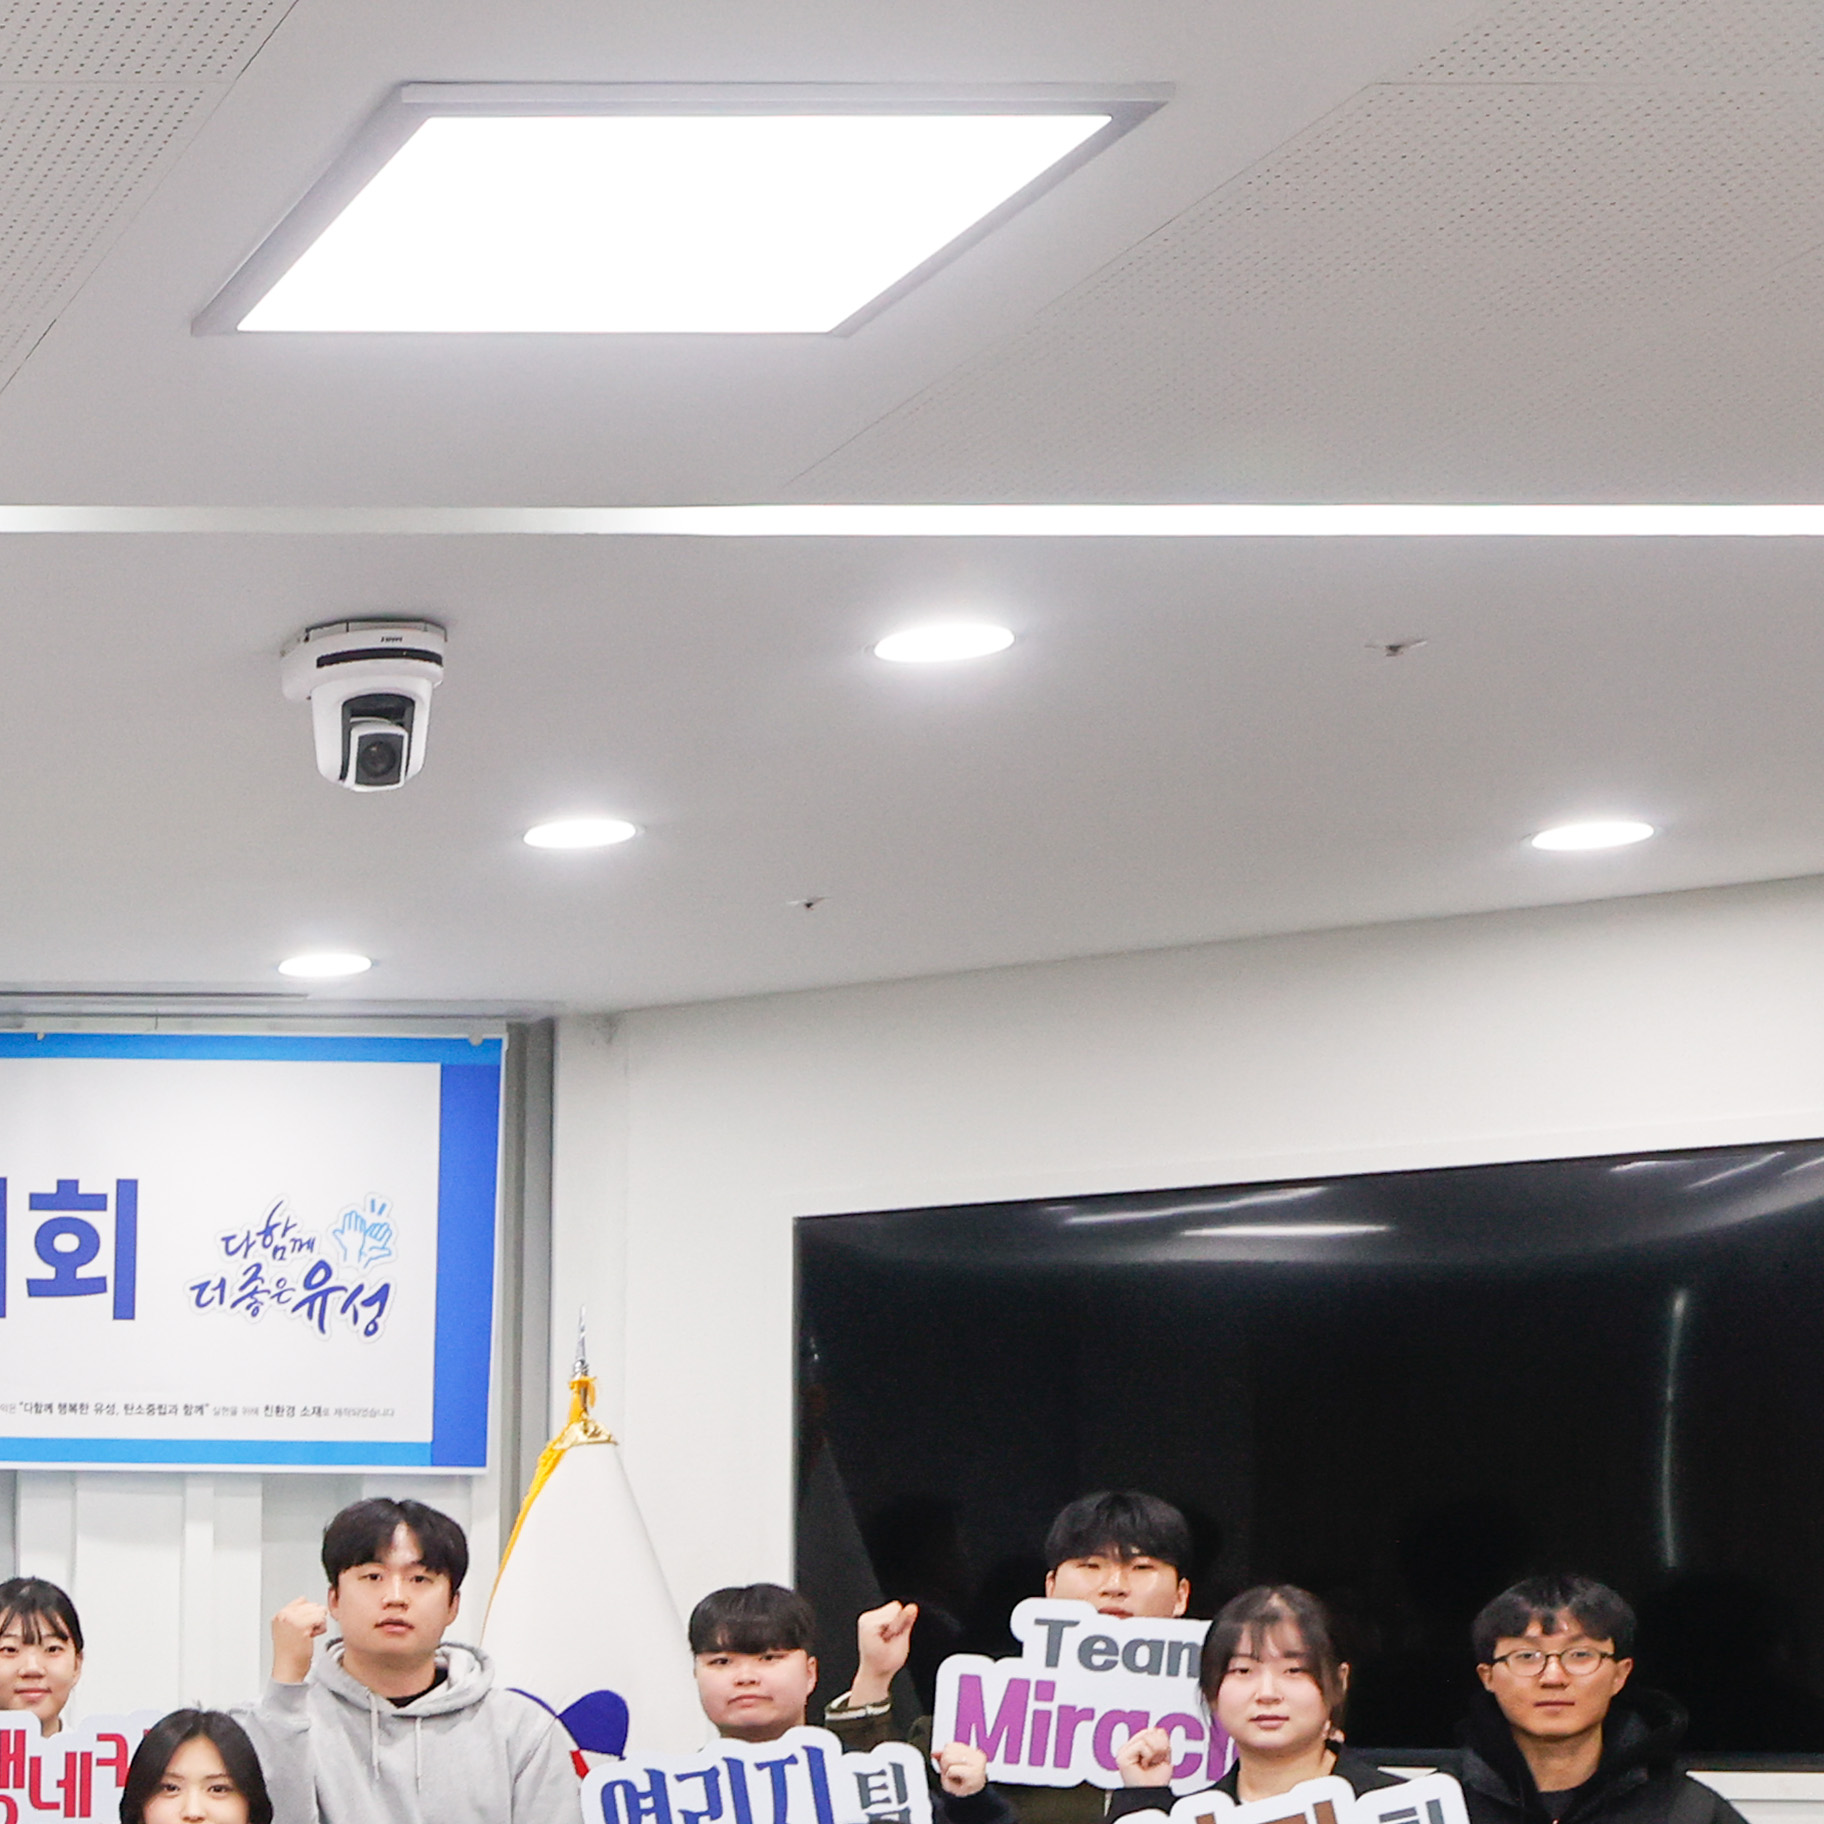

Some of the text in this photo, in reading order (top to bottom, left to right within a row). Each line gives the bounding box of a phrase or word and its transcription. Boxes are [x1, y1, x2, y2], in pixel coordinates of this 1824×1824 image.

[220, 1200, 316, 1261] 다함께
[188, 1259, 391, 1338] 더 좋은 유성
[954, 1673, 1240, 1782] Miracl
